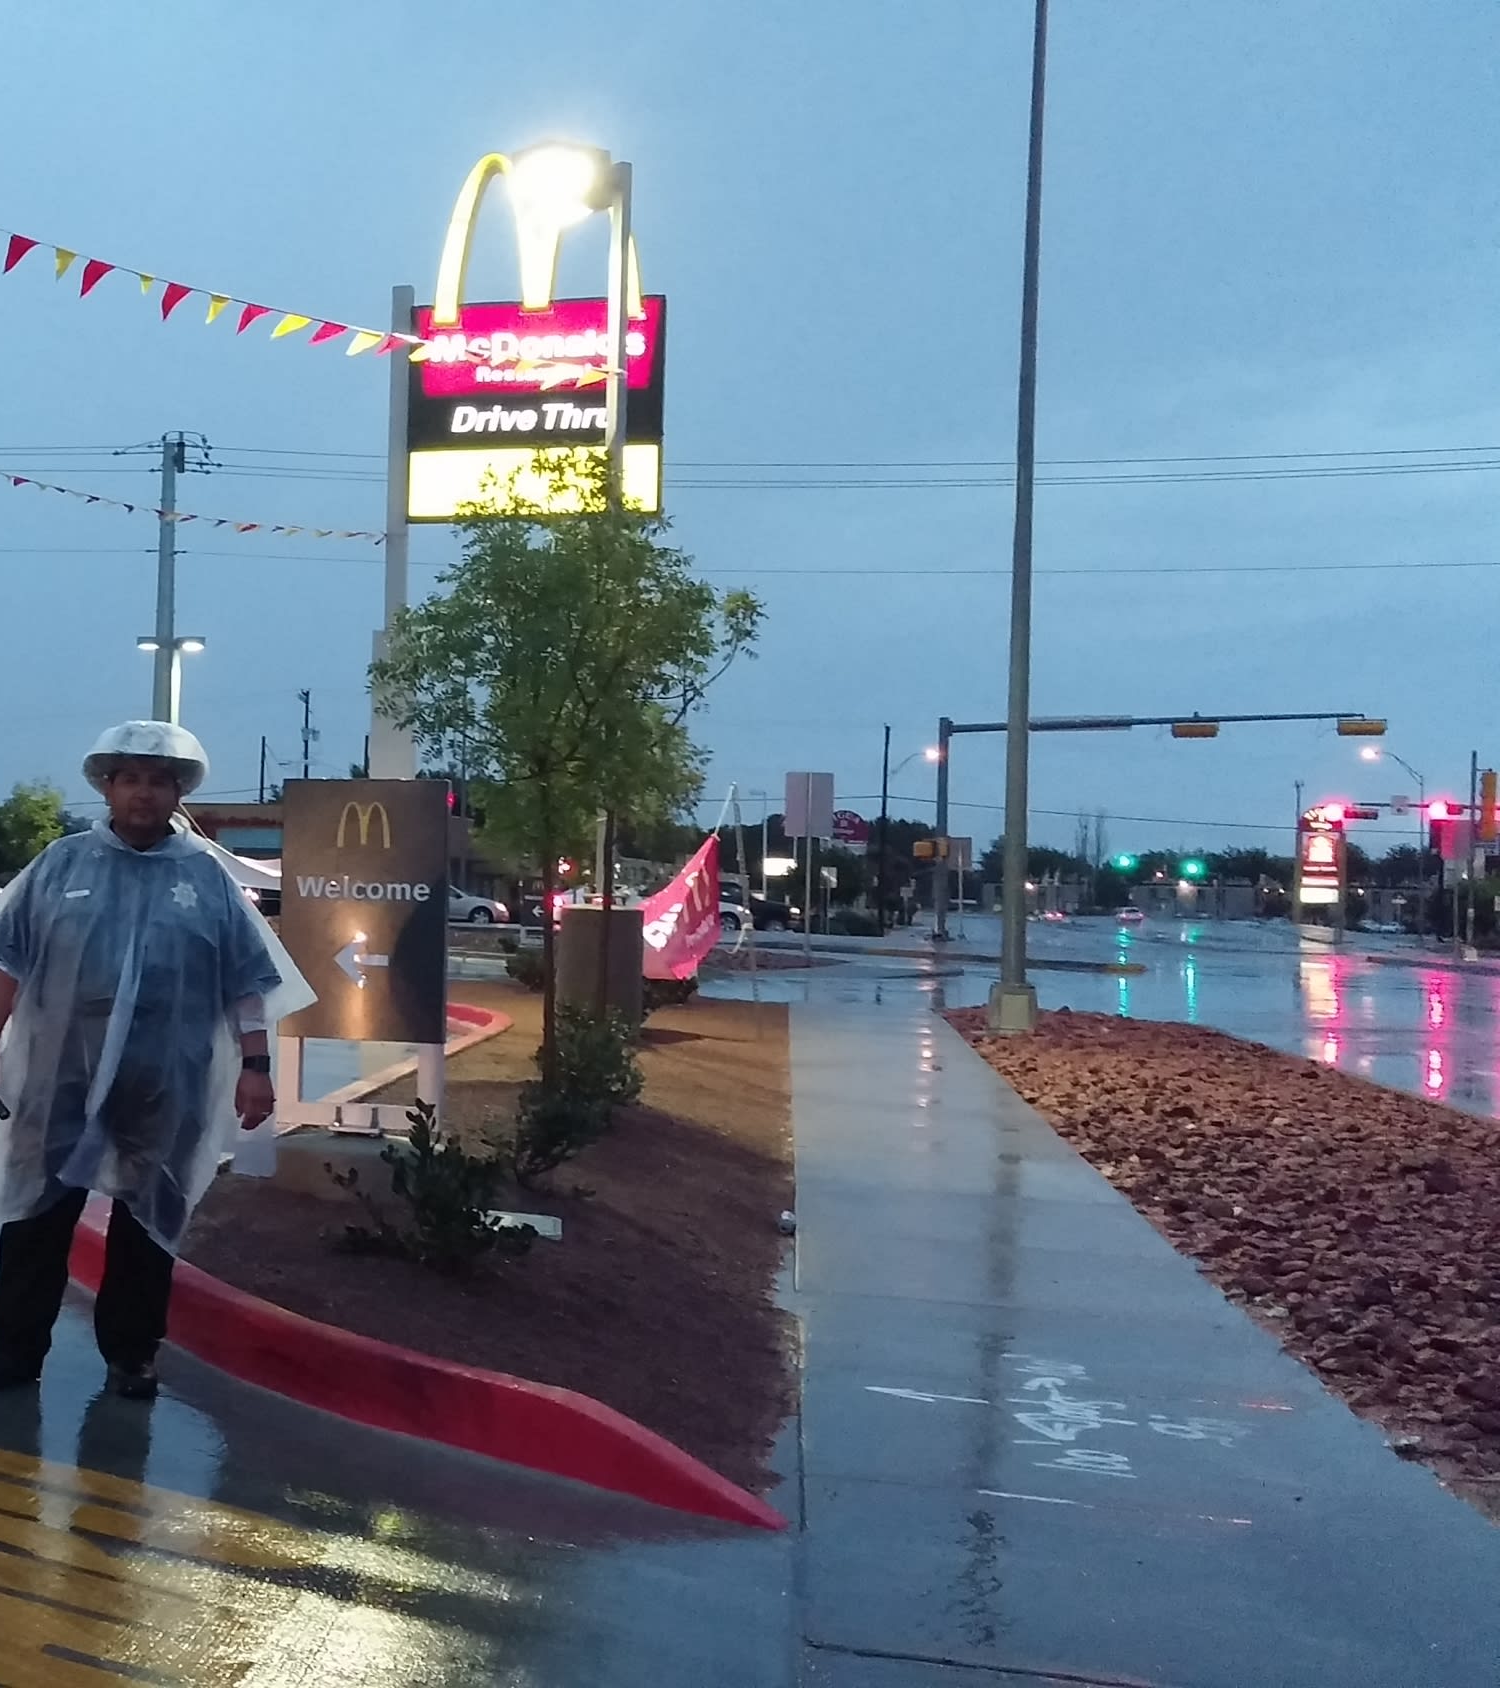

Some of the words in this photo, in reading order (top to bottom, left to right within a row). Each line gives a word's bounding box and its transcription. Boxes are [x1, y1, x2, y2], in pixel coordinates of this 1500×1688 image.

[431, 329, 646, 363] McDonals
[451, 405, 538, 433] Drive
[296, 875, 431, 901] Welcome
